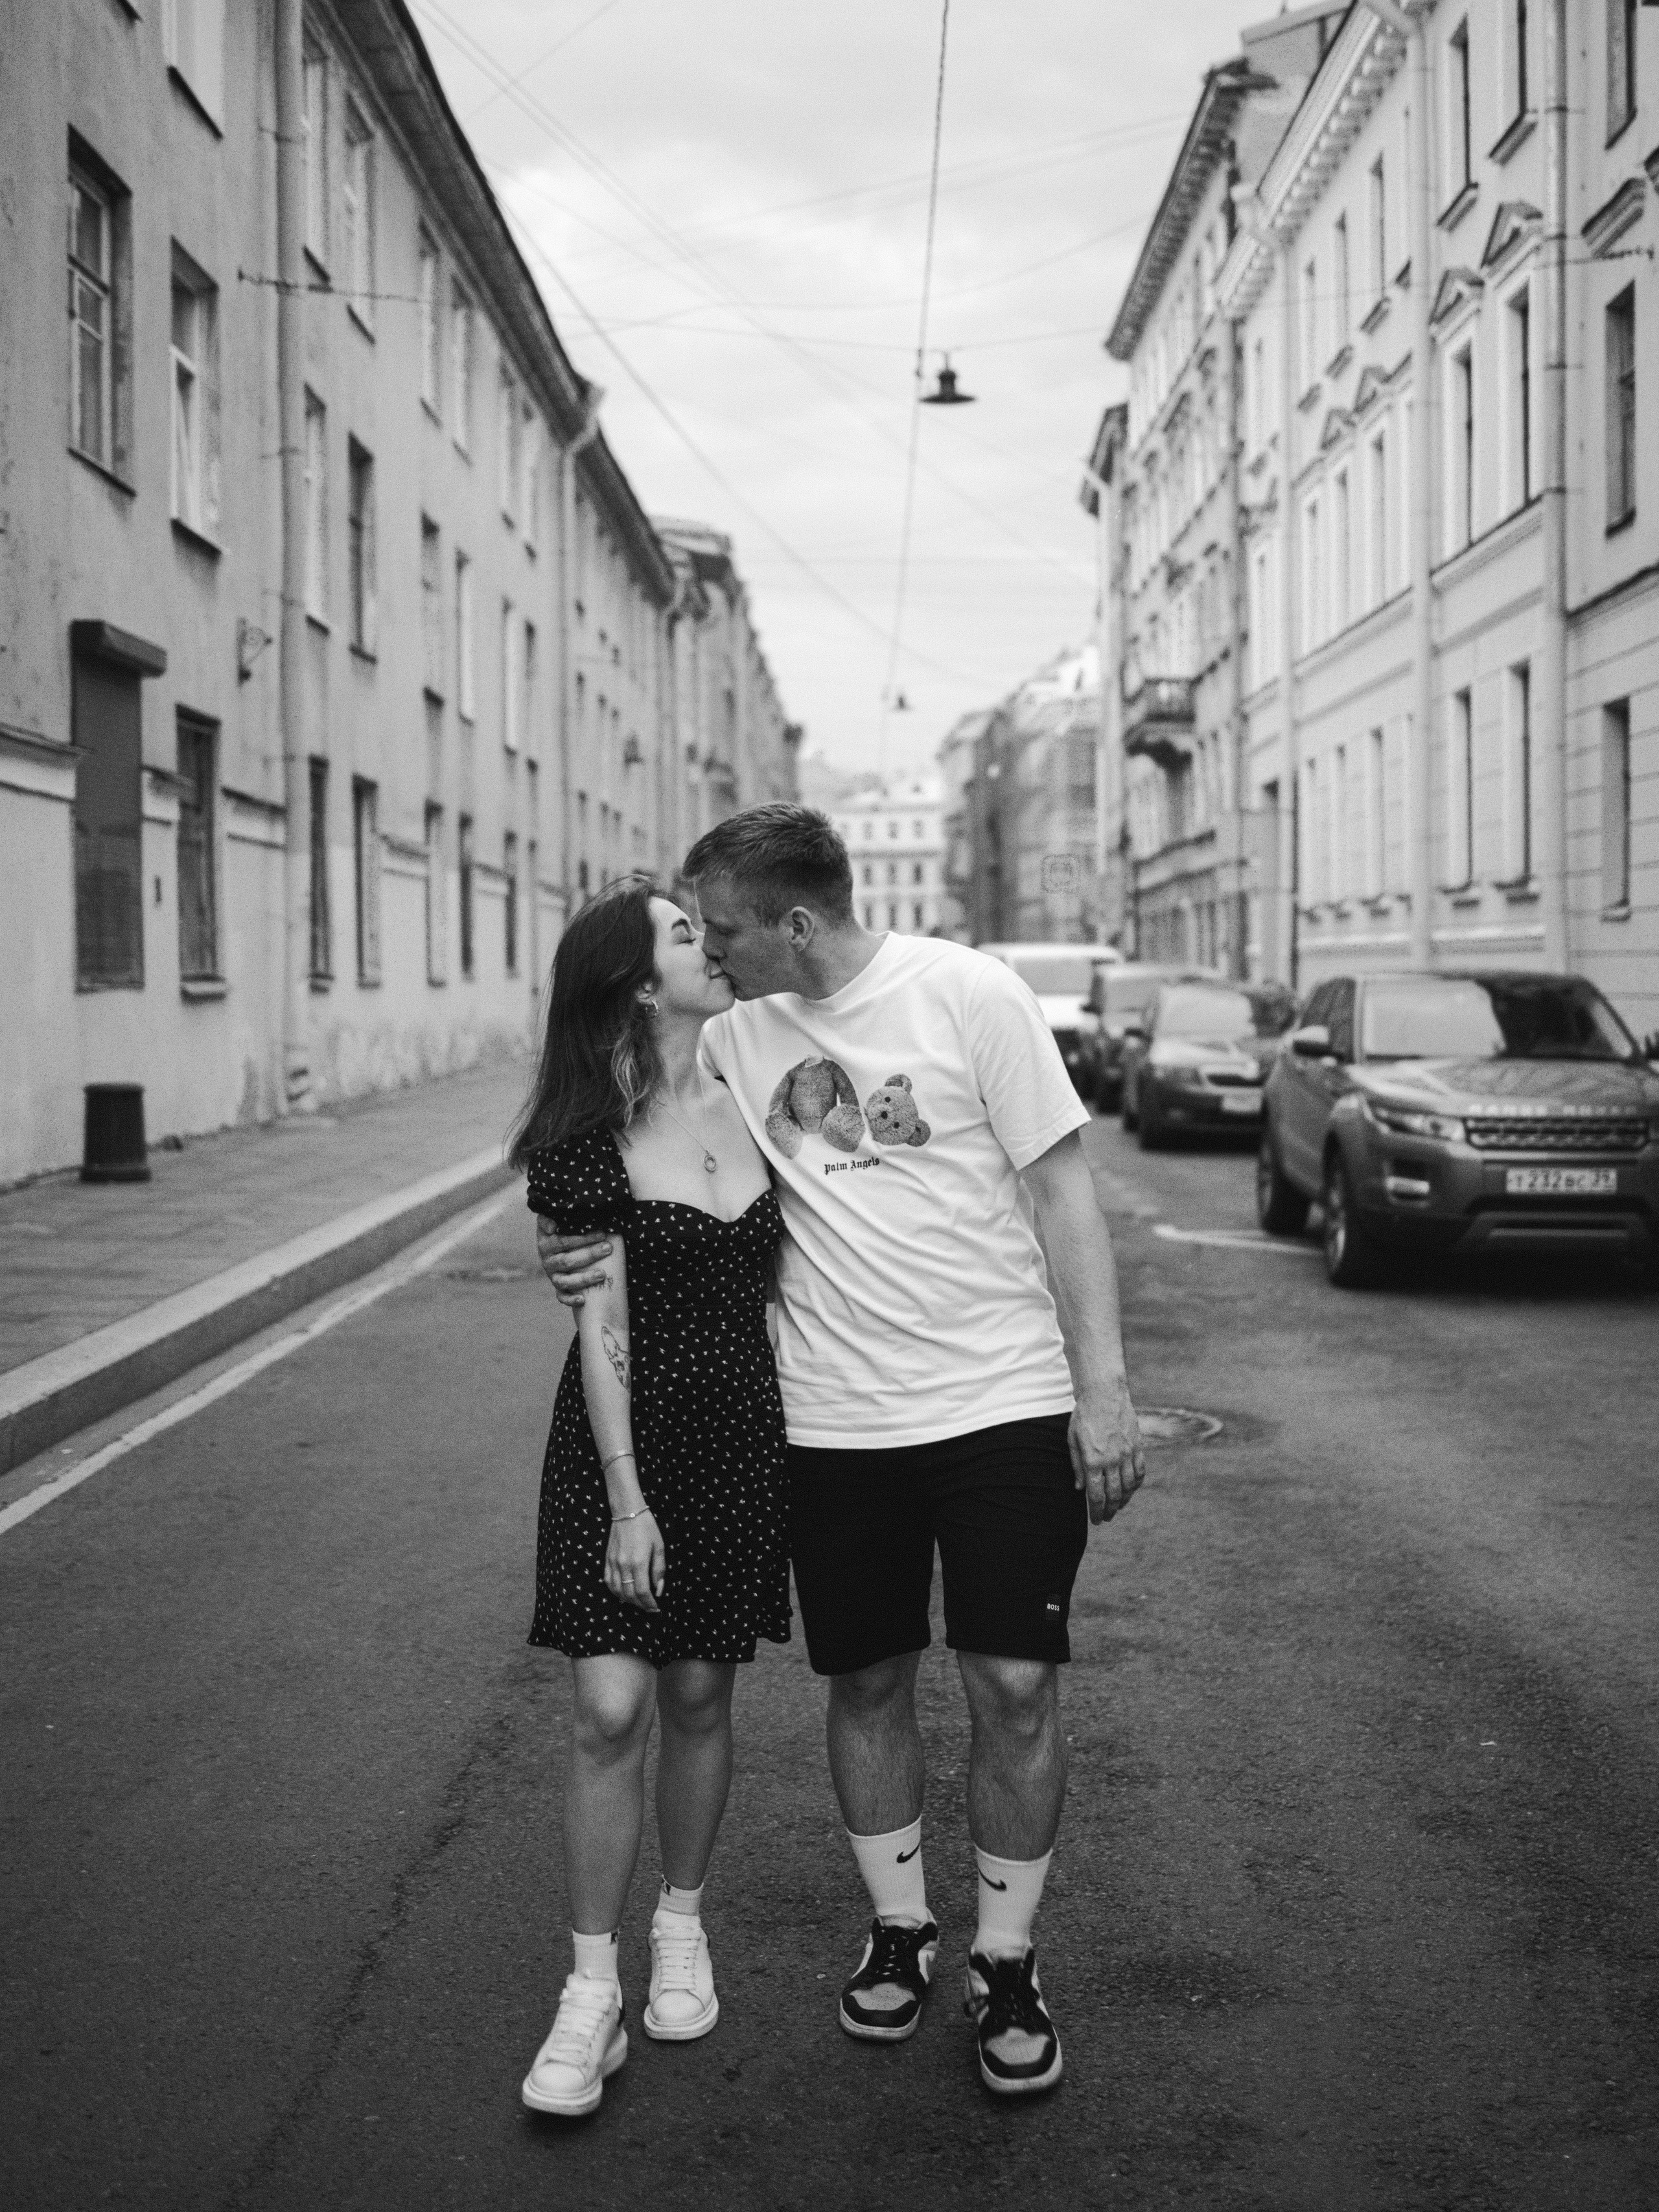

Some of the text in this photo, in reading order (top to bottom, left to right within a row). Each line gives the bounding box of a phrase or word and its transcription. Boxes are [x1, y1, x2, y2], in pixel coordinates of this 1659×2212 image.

[824, 1156, 880, 1175] Palm Angels
[1047, 1603, 1060, 1611] BOSS
